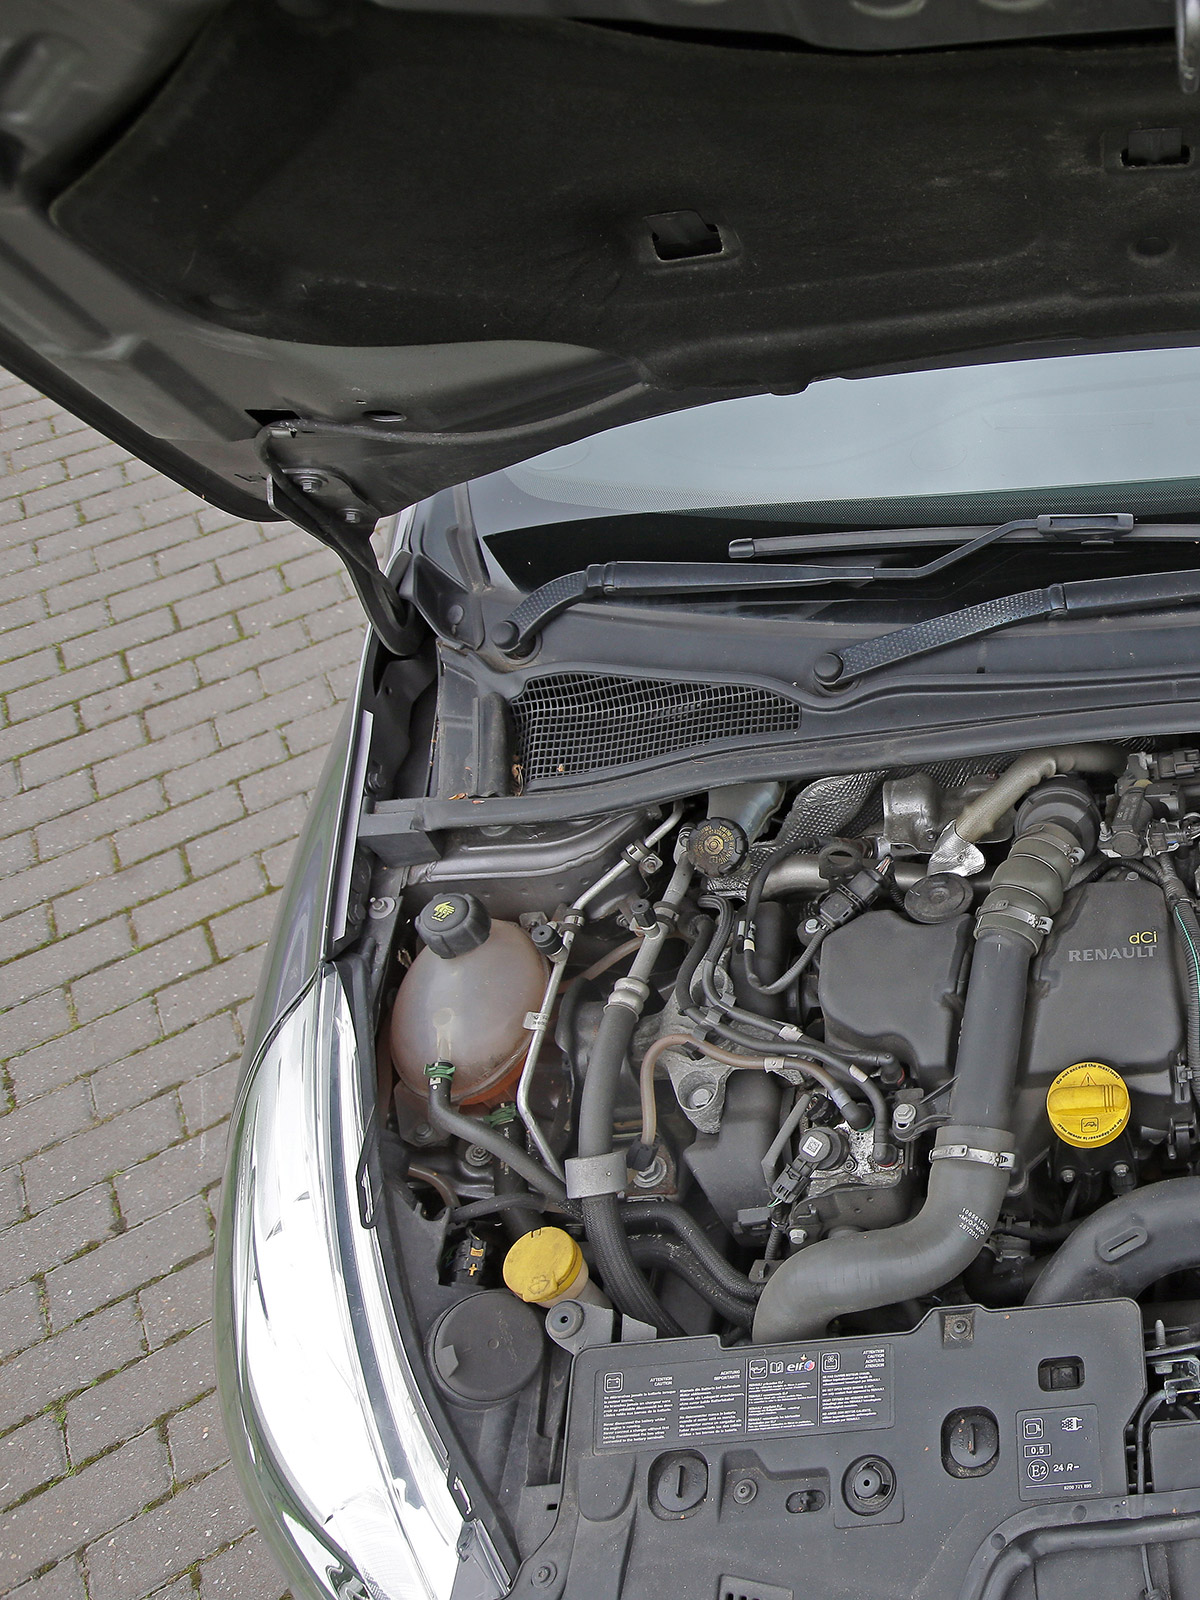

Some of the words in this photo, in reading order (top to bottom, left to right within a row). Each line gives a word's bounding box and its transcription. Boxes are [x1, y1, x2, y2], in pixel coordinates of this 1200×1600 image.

[1129, 931, 1157, 944] dCi
[1068, 945, 1157, 962] RENAULT
[1070, 1064, 1088, 1073] exceed
[1110, 1070, 1120, 1080] level
[786, 1361, 805, 1372] elf
[1031, 1447, 1044, 1455] 0,5
[1031, 1464, 1046, 1477] E2
